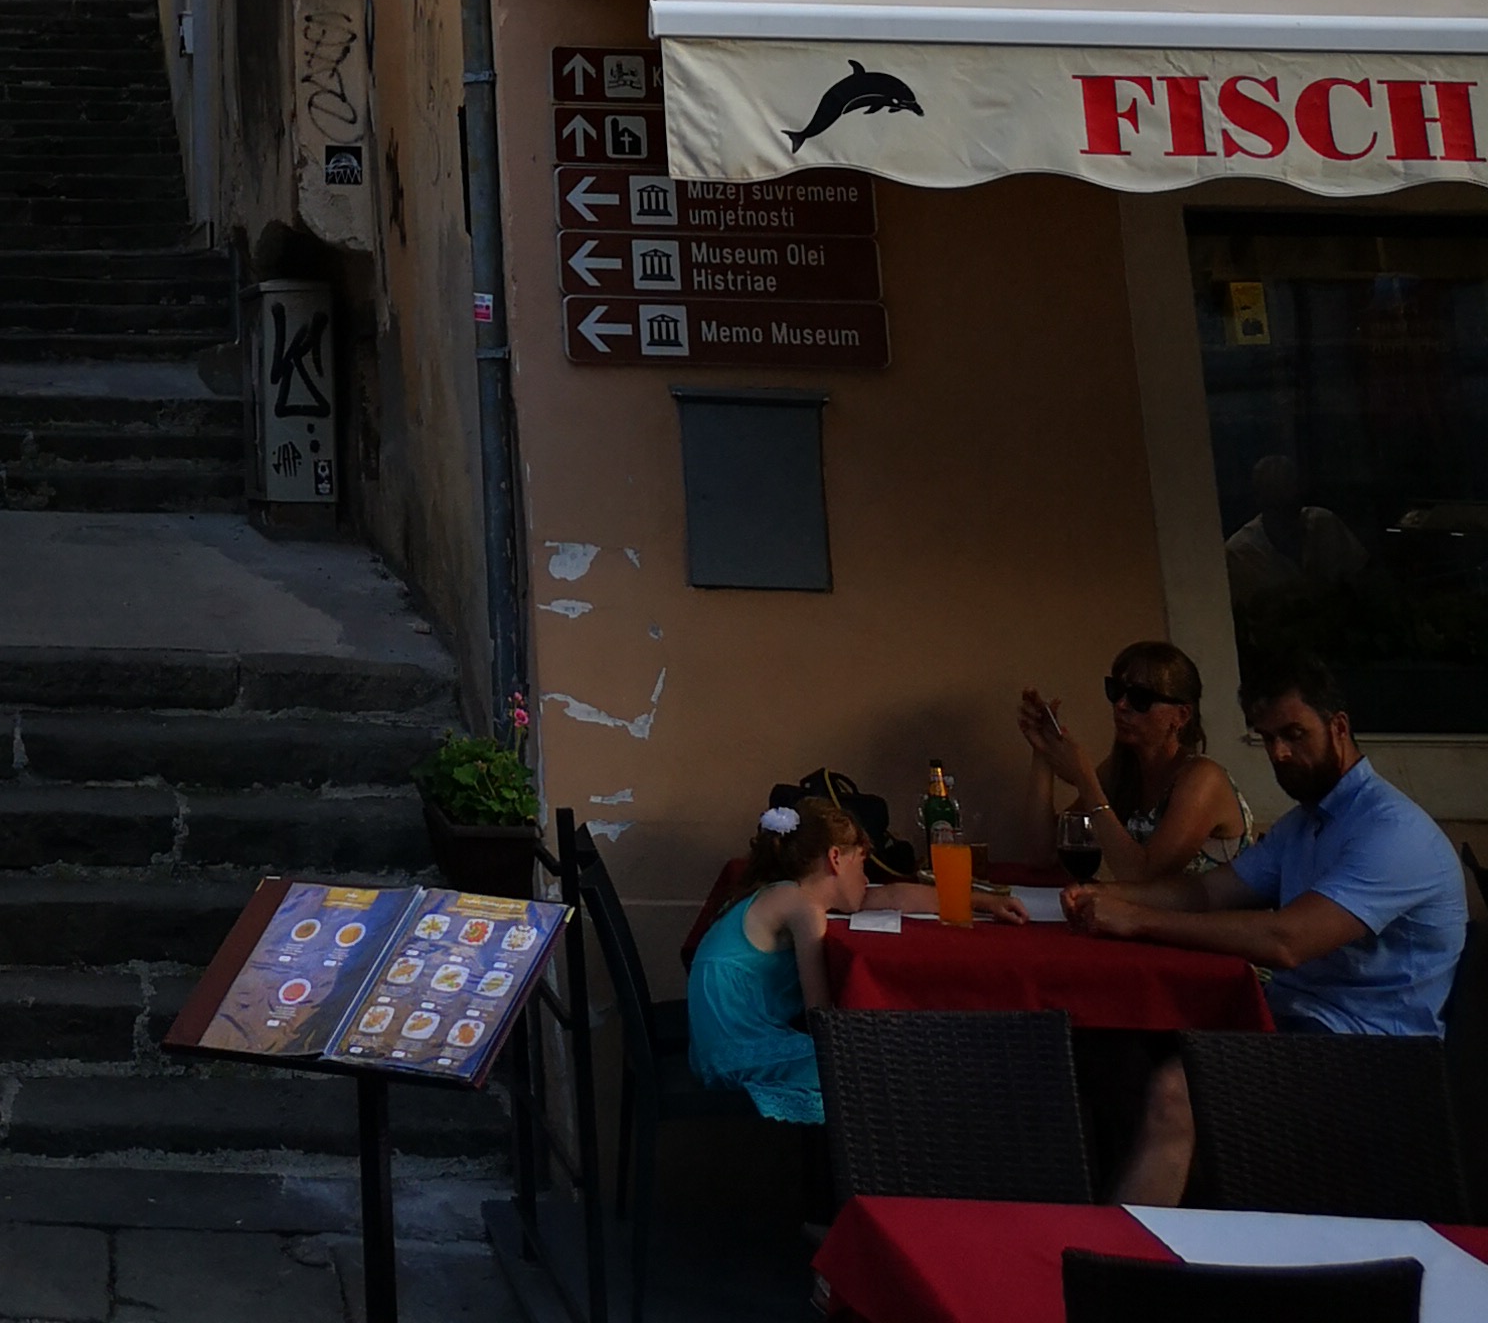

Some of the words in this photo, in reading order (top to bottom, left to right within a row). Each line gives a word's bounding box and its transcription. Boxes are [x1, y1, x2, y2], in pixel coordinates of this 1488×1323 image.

[1072, 74, 1487, 163] FISCH
[687, 181, 744, 204] Muzej
[752, 183, 858, 202] suvremene
[689, 206, 795, 231] umjetnosti
[691, 241, 778, 265] Museum
[787, 243, 825, 266] Olei
[693, 268, 777, 292] Histriae
[701, 320, 763, 343] Memo
[771, 322, 860, 346] Museum
